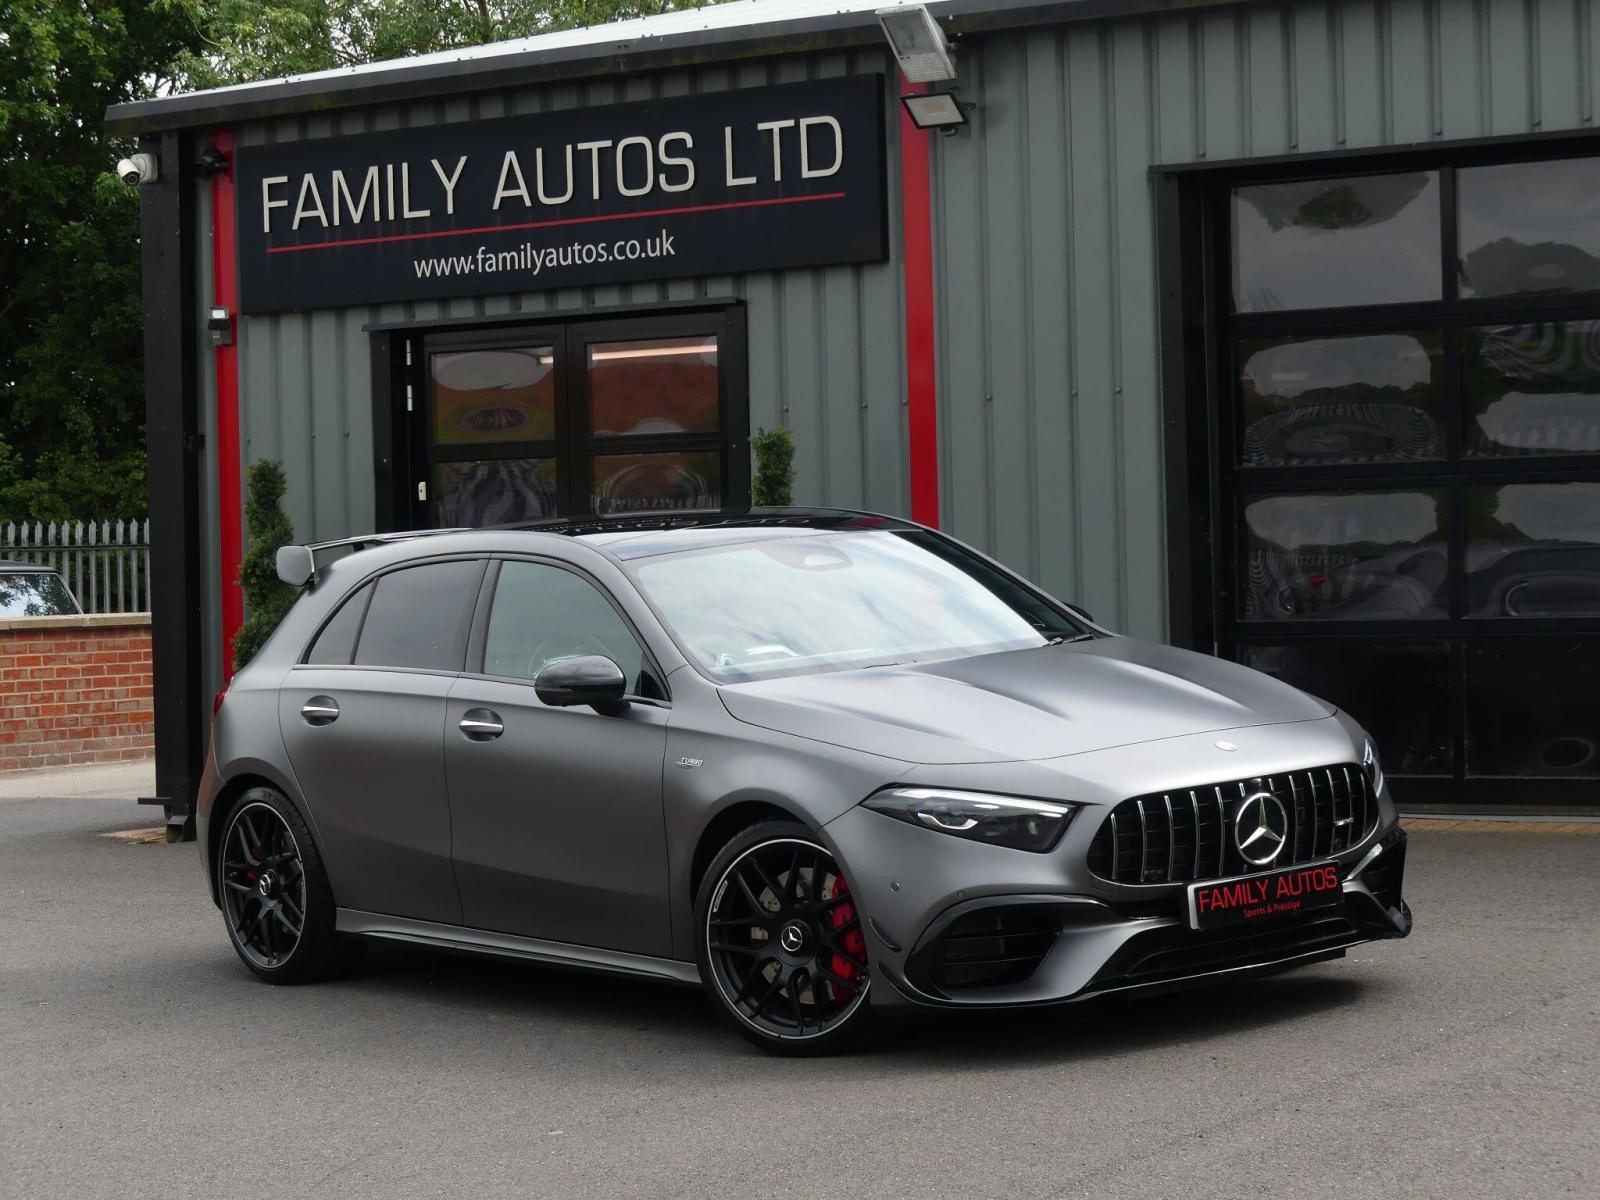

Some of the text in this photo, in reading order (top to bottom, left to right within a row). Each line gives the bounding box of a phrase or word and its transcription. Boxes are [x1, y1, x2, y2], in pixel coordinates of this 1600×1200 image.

[262, 115, 843, 233] FAMILY AUTOS LTD
[413, 229, 676, 277] www.familyautos.co.uk
[1199, 867, 1337, 911] FAMILY AUTOS
[1244, 899, 1301, 917] Sports & Prestige
